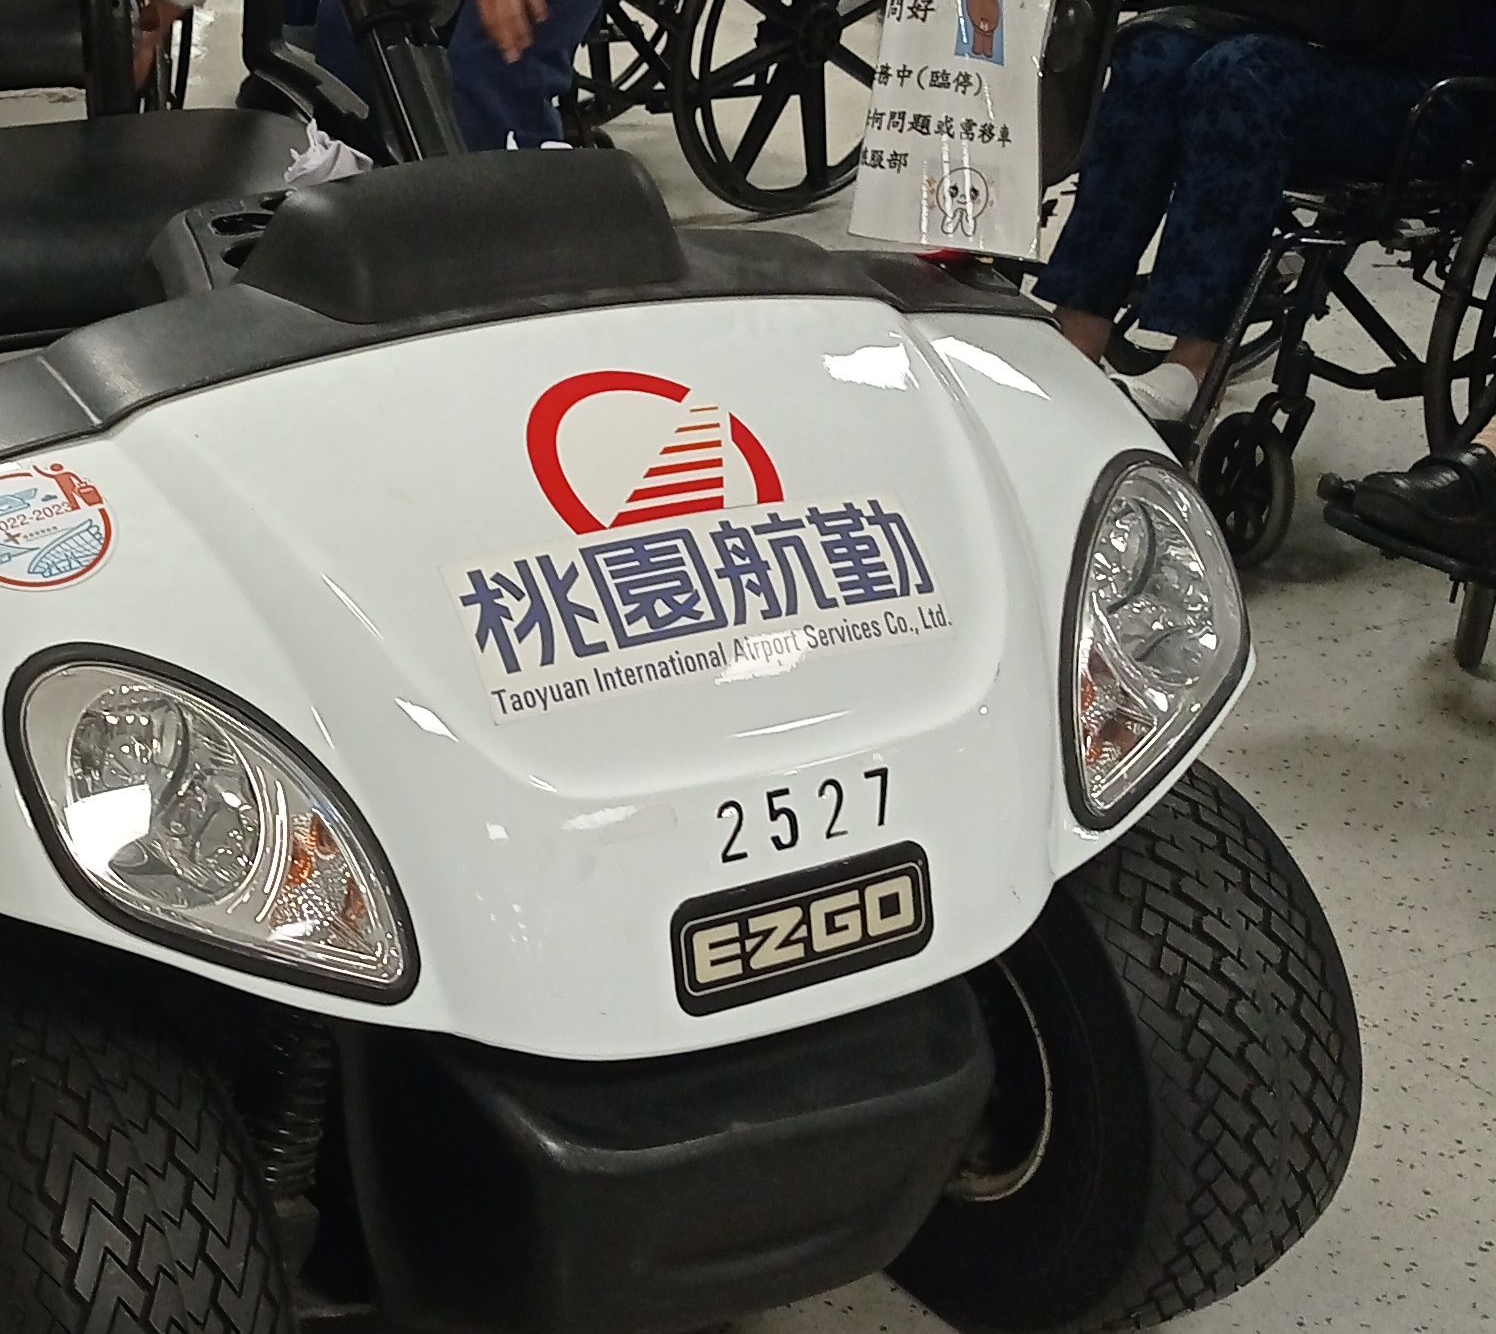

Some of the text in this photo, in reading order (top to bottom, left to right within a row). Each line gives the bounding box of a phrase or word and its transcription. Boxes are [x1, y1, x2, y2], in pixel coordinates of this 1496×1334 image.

[459, 499, 935, 674] 桃園航勤
[490, 603, 953, 715] Taoyuan International Airport Services Co., Ltd.
[716, 767, 889, 863] 2527
